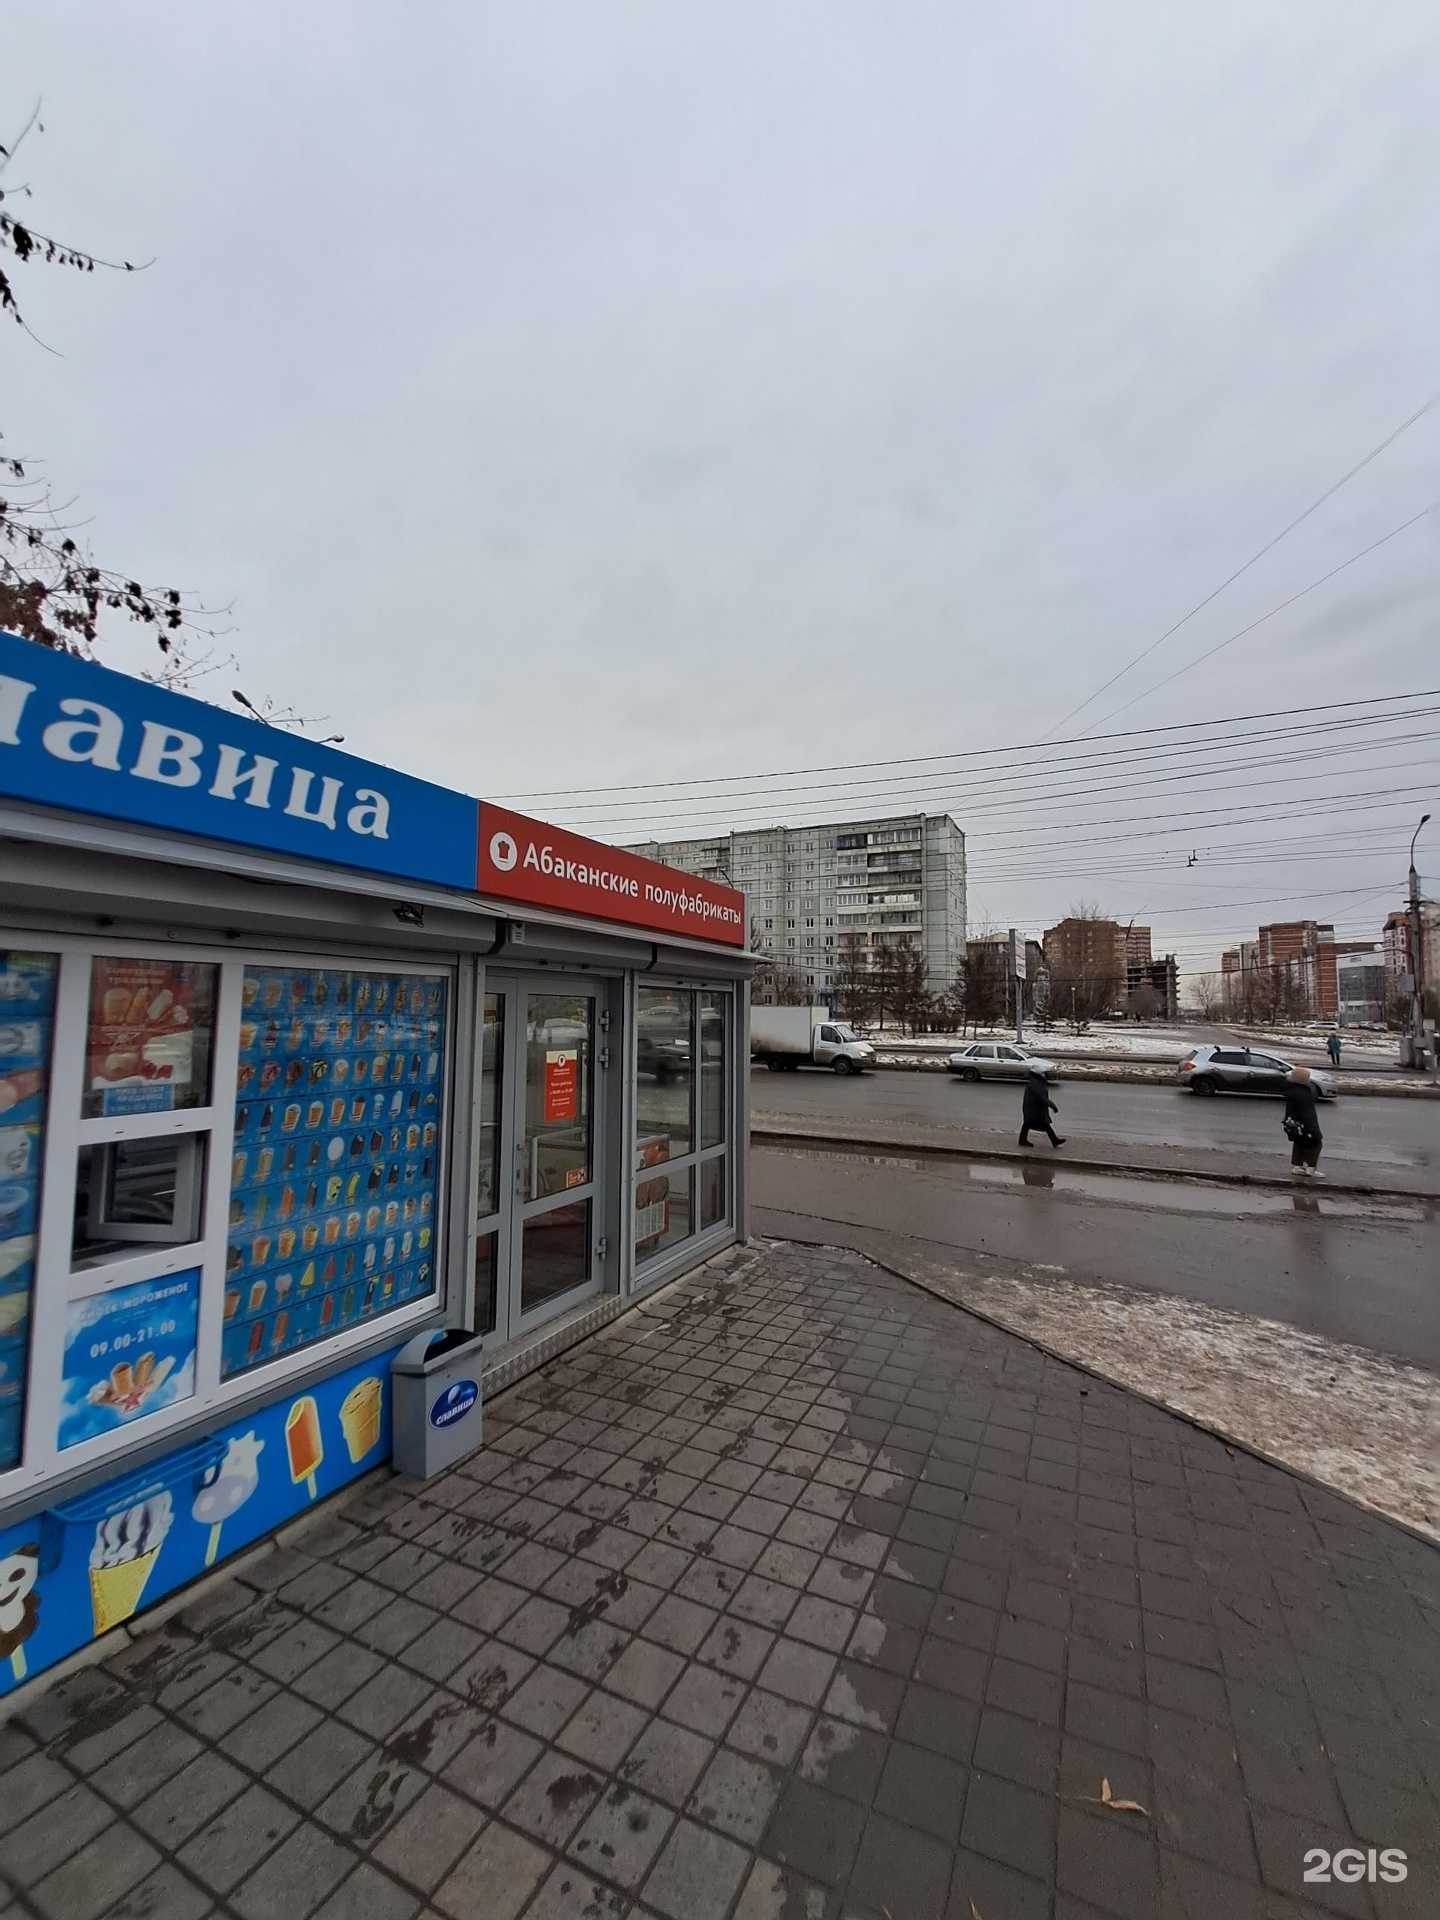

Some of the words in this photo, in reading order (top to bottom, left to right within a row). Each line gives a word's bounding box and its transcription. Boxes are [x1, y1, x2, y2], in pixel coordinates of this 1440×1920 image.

[523, 842, 639, 898] Абаканские
[645, 883, 741, 925] полуфабрикаты
[89, 1319, 176, 1359] 09.00-21.00
